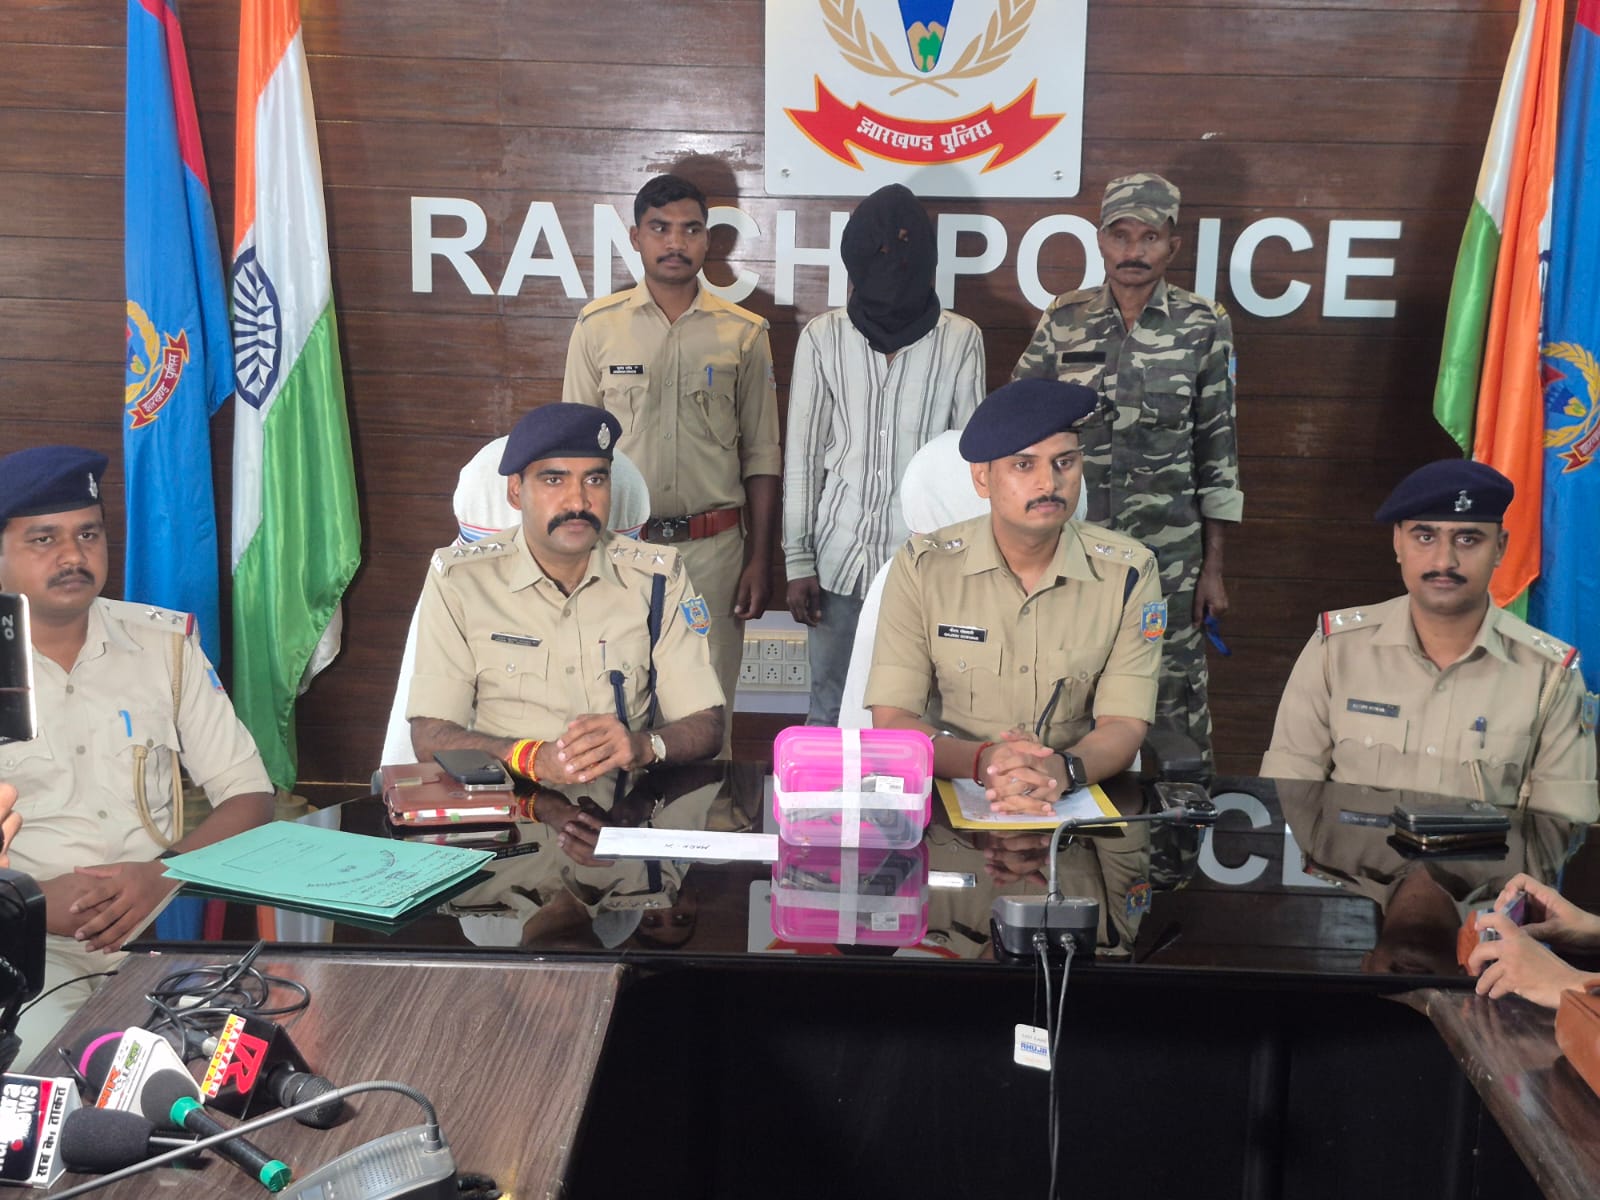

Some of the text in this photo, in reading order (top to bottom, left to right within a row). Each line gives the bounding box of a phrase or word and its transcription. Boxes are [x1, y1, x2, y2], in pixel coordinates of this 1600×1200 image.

[856, 116, 993, 154] झारखण्ड पुलिस
[410, 196, 1402, 319] RANCH POICE
[204, 1022, 233, 1083] MEDIA
[47, 1085, 67, 1125] ताकत
